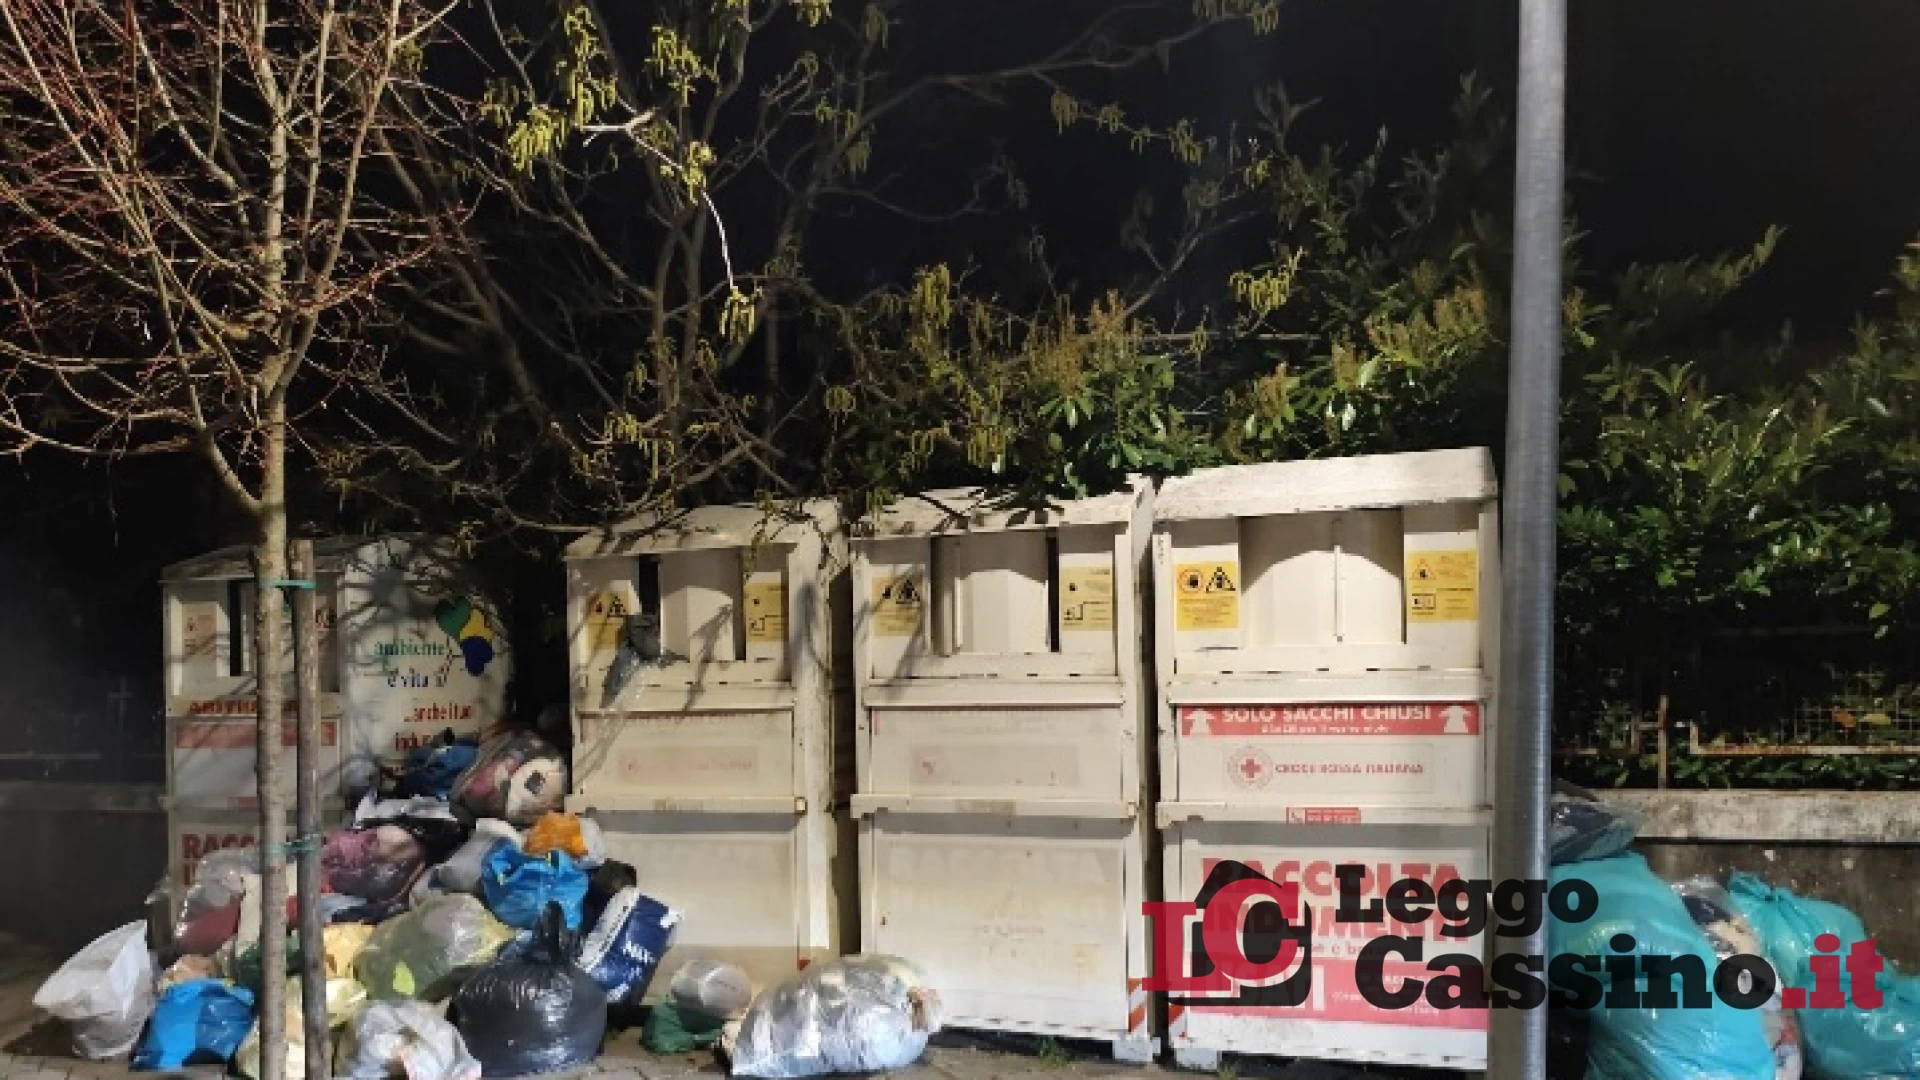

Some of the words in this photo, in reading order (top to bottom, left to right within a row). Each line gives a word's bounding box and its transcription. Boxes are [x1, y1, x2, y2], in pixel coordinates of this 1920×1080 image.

[1222, 706, 1277, 722] SOLO
[1283, 705, 1354, 721] SACCHI
[1362, 704, 1431, 720] CHIUSI
[1274, 763, 1314, 774] CROCE
[1320, 763, 1362, 774] ROSSA
[1365, 763, 1424, 774] ITALIANA
